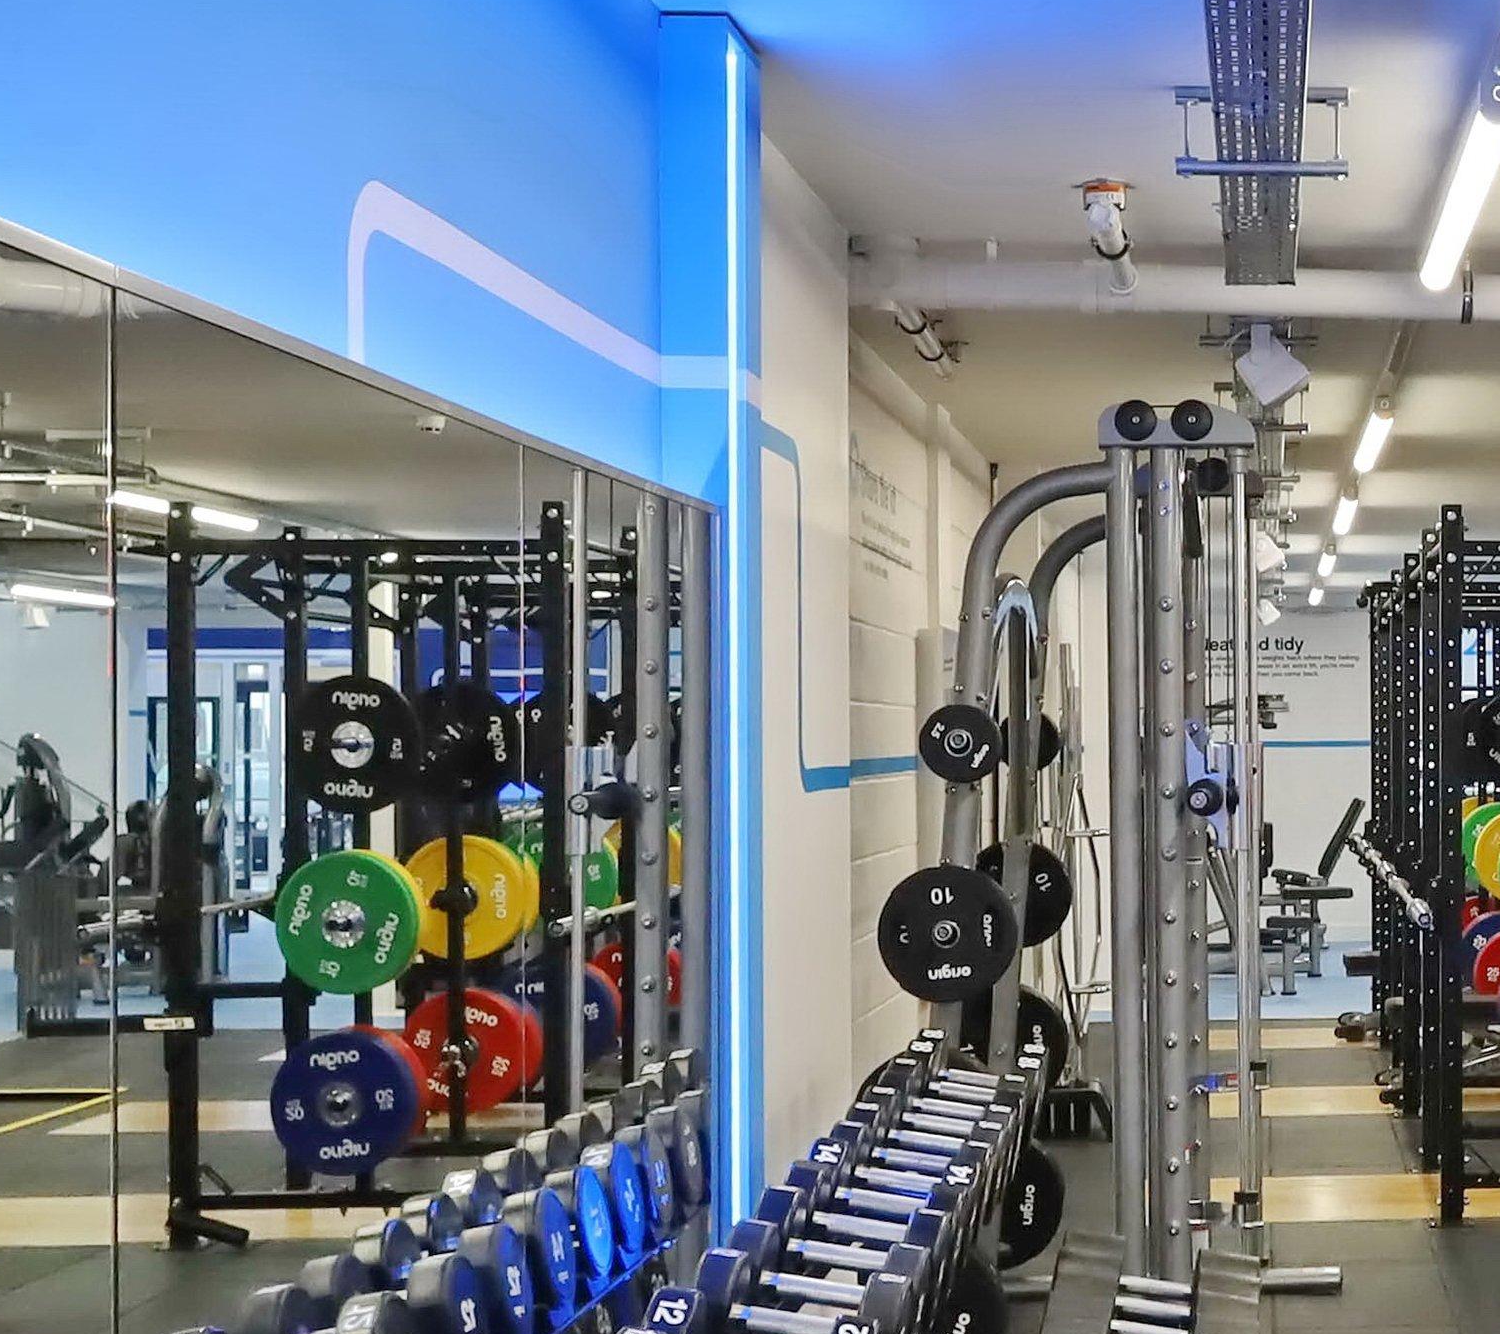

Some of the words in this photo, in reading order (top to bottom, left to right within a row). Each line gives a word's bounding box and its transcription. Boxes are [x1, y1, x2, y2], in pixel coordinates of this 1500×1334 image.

[1275, 636, 1304, 654] tidy
[1035, 873, 1052, 892] 10
[930, 887, 955, 905] 10
[928, 964, 972, 980] origin
[813, 1143, 842, 1165] 14
[945, 1165, 975, 1186] 14
[1019, 1184, 1036, 1226] origin
[652, 1298, 689, 1325] 12
